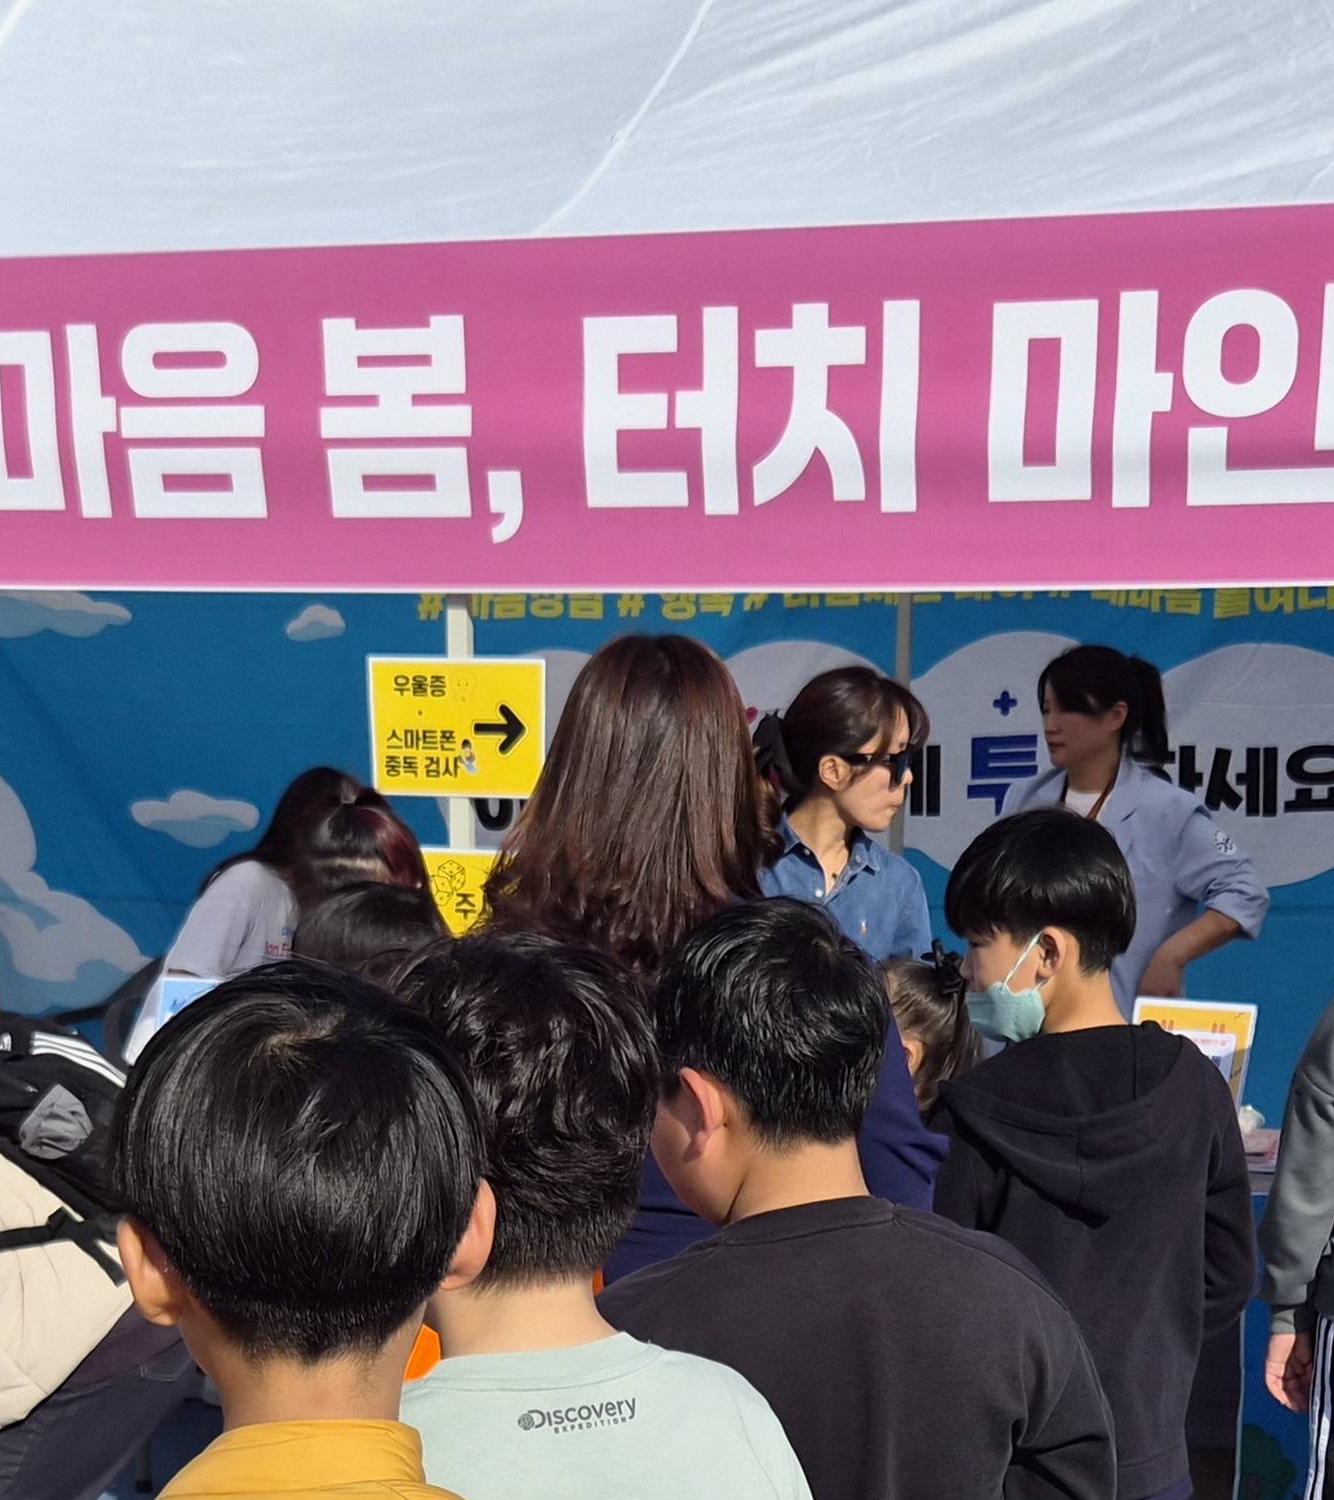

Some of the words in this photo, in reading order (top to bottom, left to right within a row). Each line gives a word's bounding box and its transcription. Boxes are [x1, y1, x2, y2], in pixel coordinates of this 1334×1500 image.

[319, 314, 524, 544] 봄,
[582, 298, 920, 515] 터치
[393, 674, 447, 697] 우울증
[386, 729, 456, 751] 스마트폰
[385, 755, 419, 778] 중독
[424, 756, 460, 778] 검사
[554, 1416, 628, 1434] EXPEDITION
